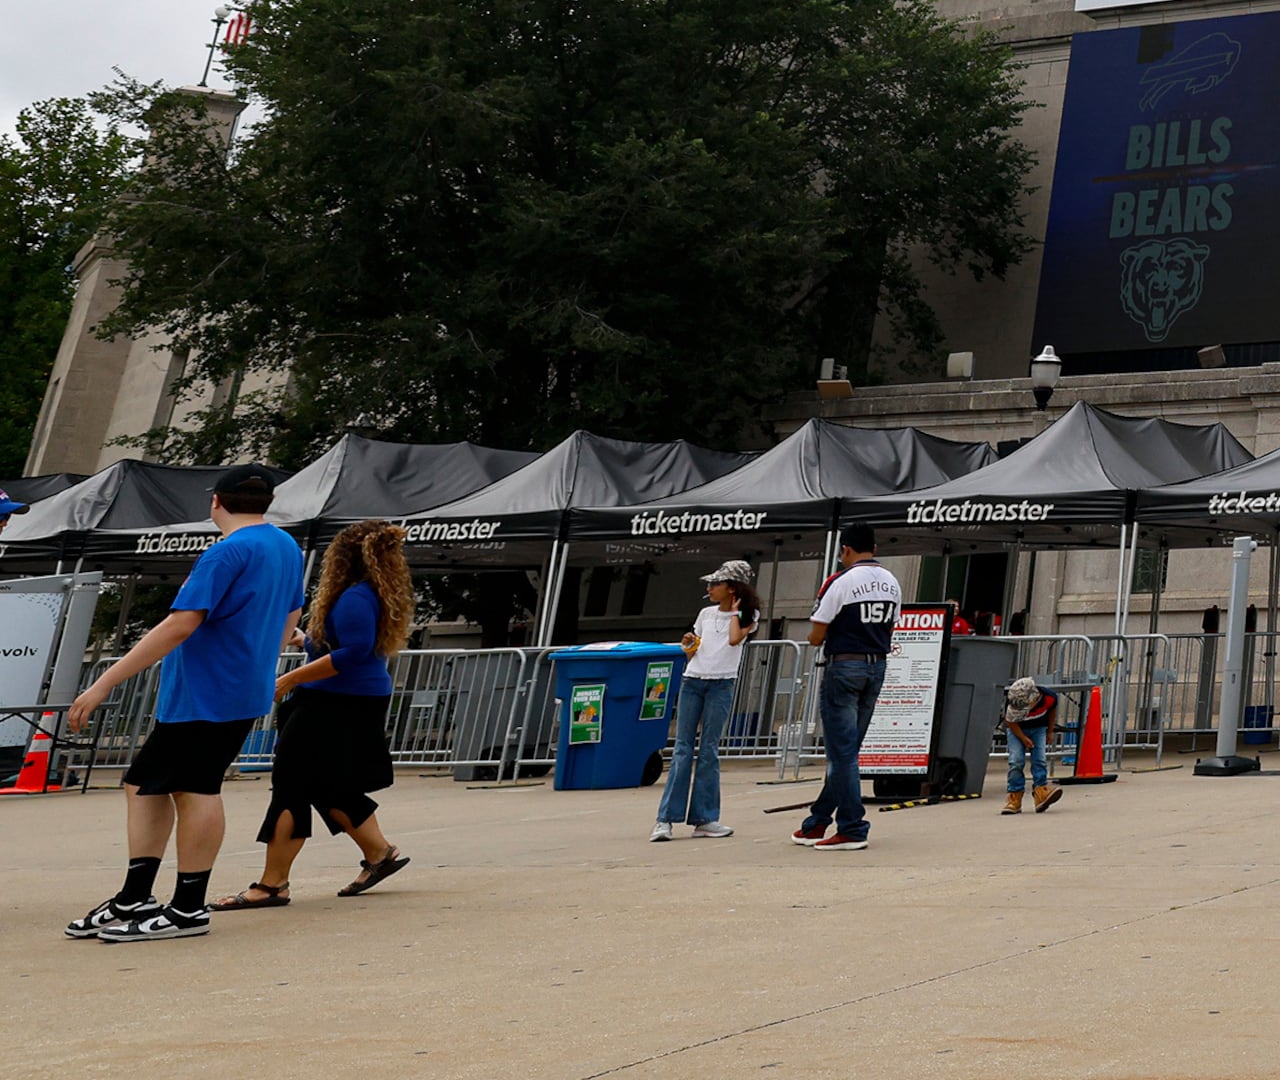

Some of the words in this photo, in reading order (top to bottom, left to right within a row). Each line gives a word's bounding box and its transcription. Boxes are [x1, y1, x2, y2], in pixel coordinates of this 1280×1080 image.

[1126, 117, 1233, 172] BILLS
[1109, 183, 1234, 239] BEARS
[630, 510, 767, 536] ticketmaster
[906, 499, 1054, 525] ticketmaster
[135, 532, 226, 554] ticketmas
[401, 519, 501, 542] ketmaster
